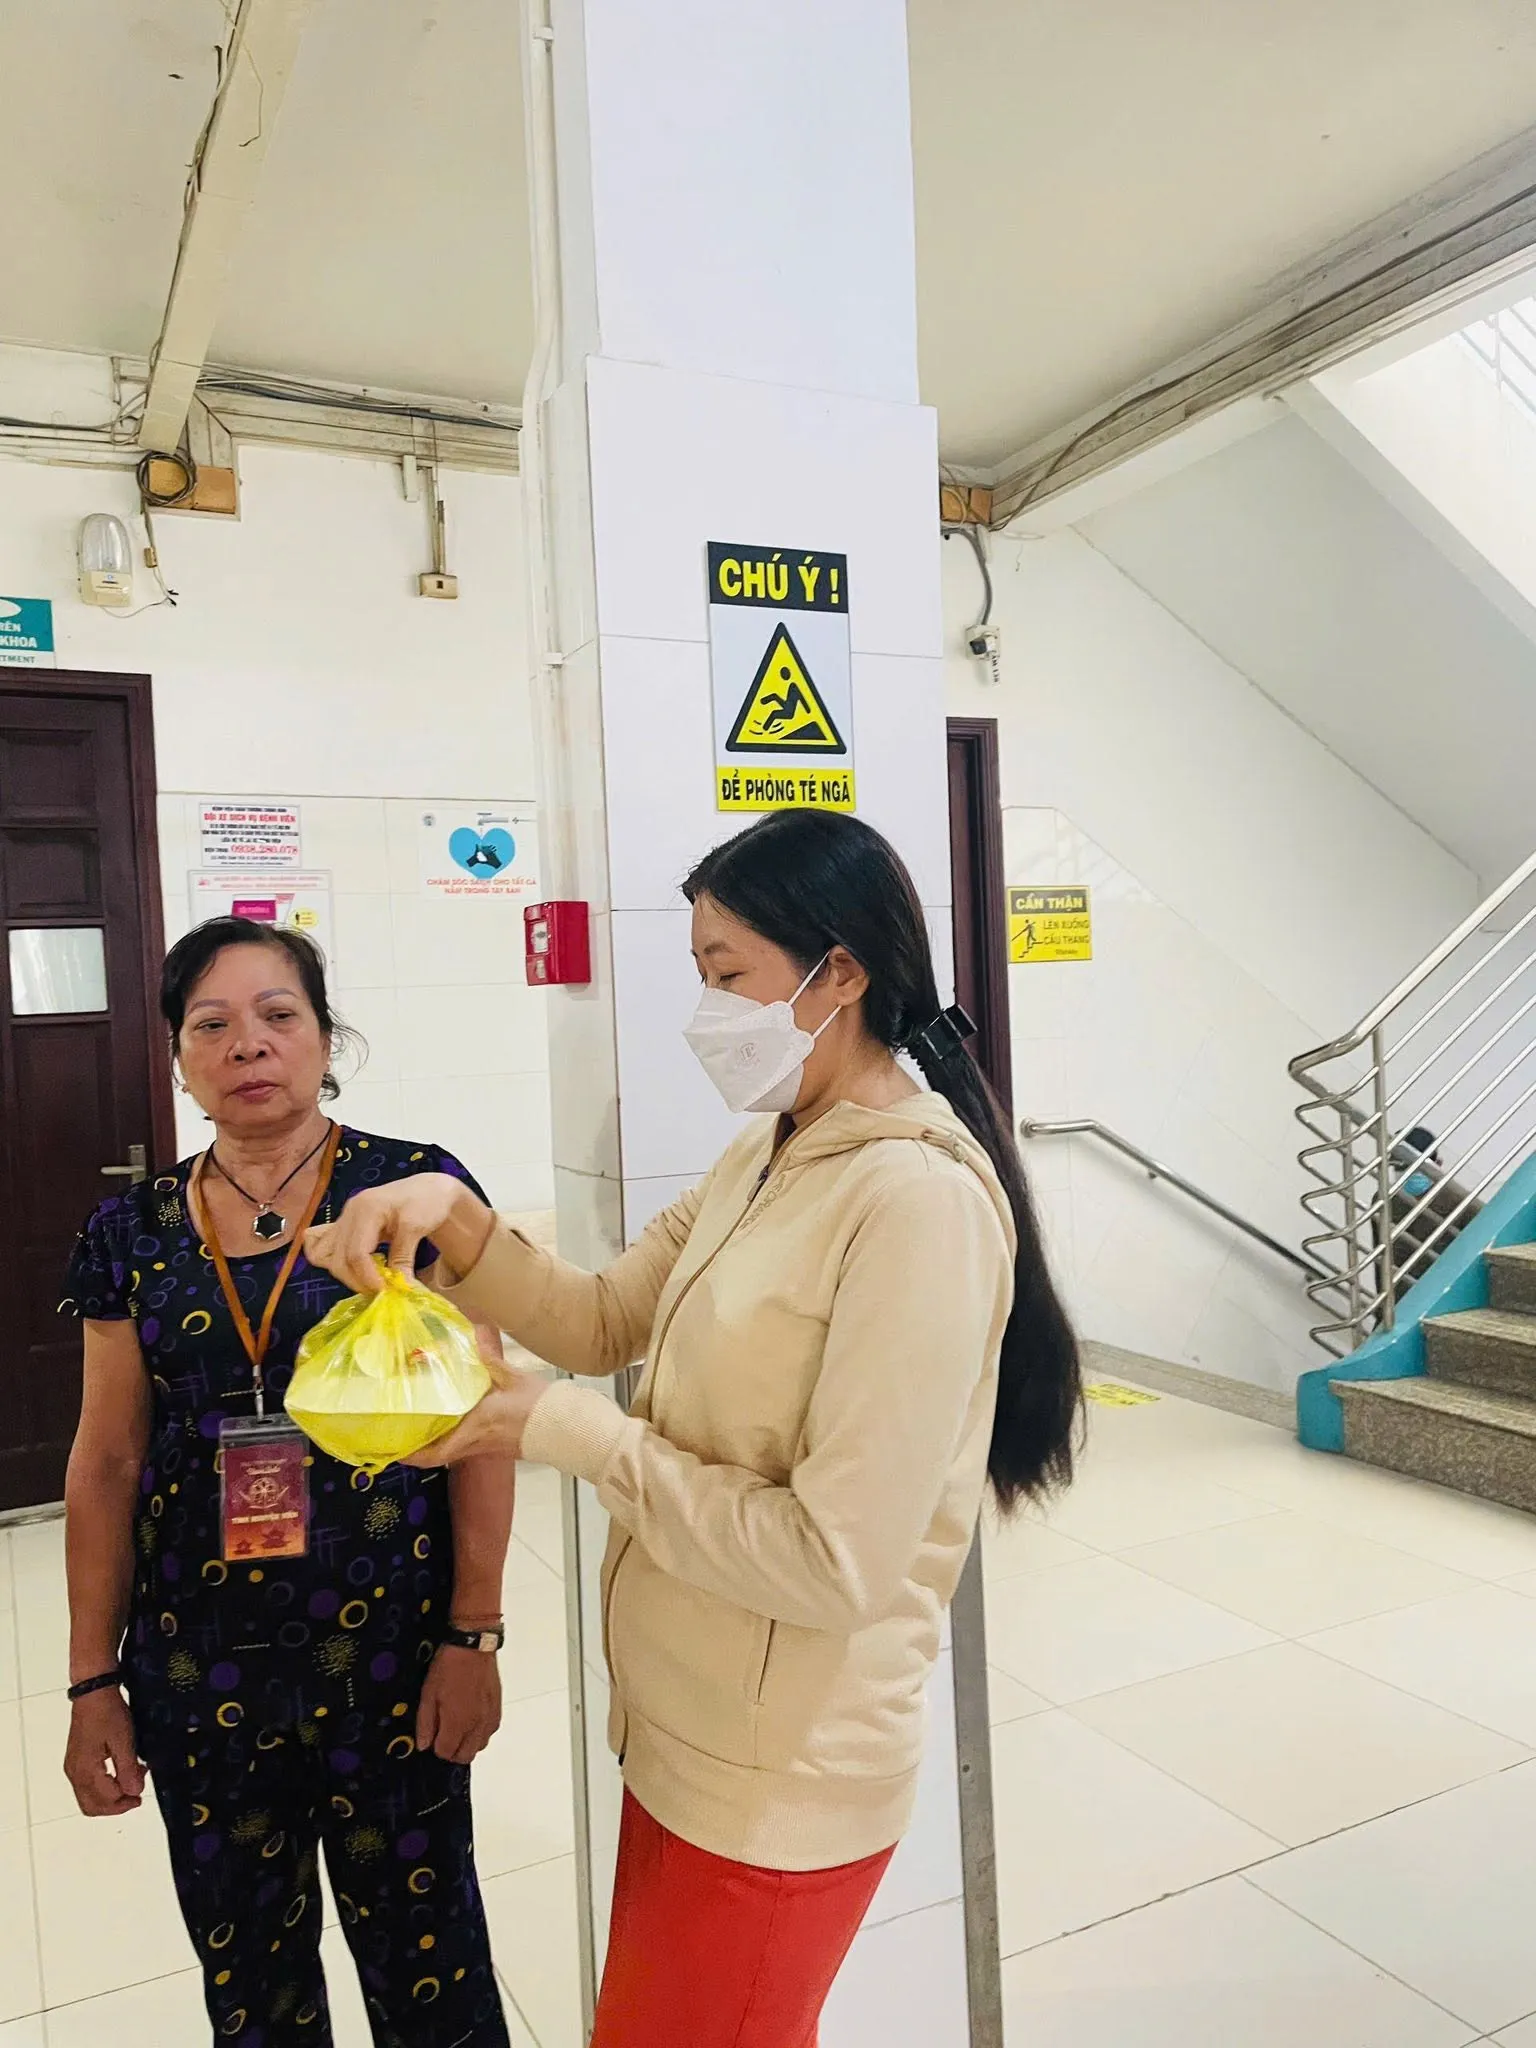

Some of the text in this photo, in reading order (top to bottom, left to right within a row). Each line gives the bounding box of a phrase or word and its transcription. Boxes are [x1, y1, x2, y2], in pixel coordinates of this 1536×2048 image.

[718, 553, 788, 601] CHÚ
[798, 556, 820, 602] Ý
[0, 636, 37, 648] KHOA
[721, 768, 851, 802] ĐỂ PHÒNG TÉ NGÃ
